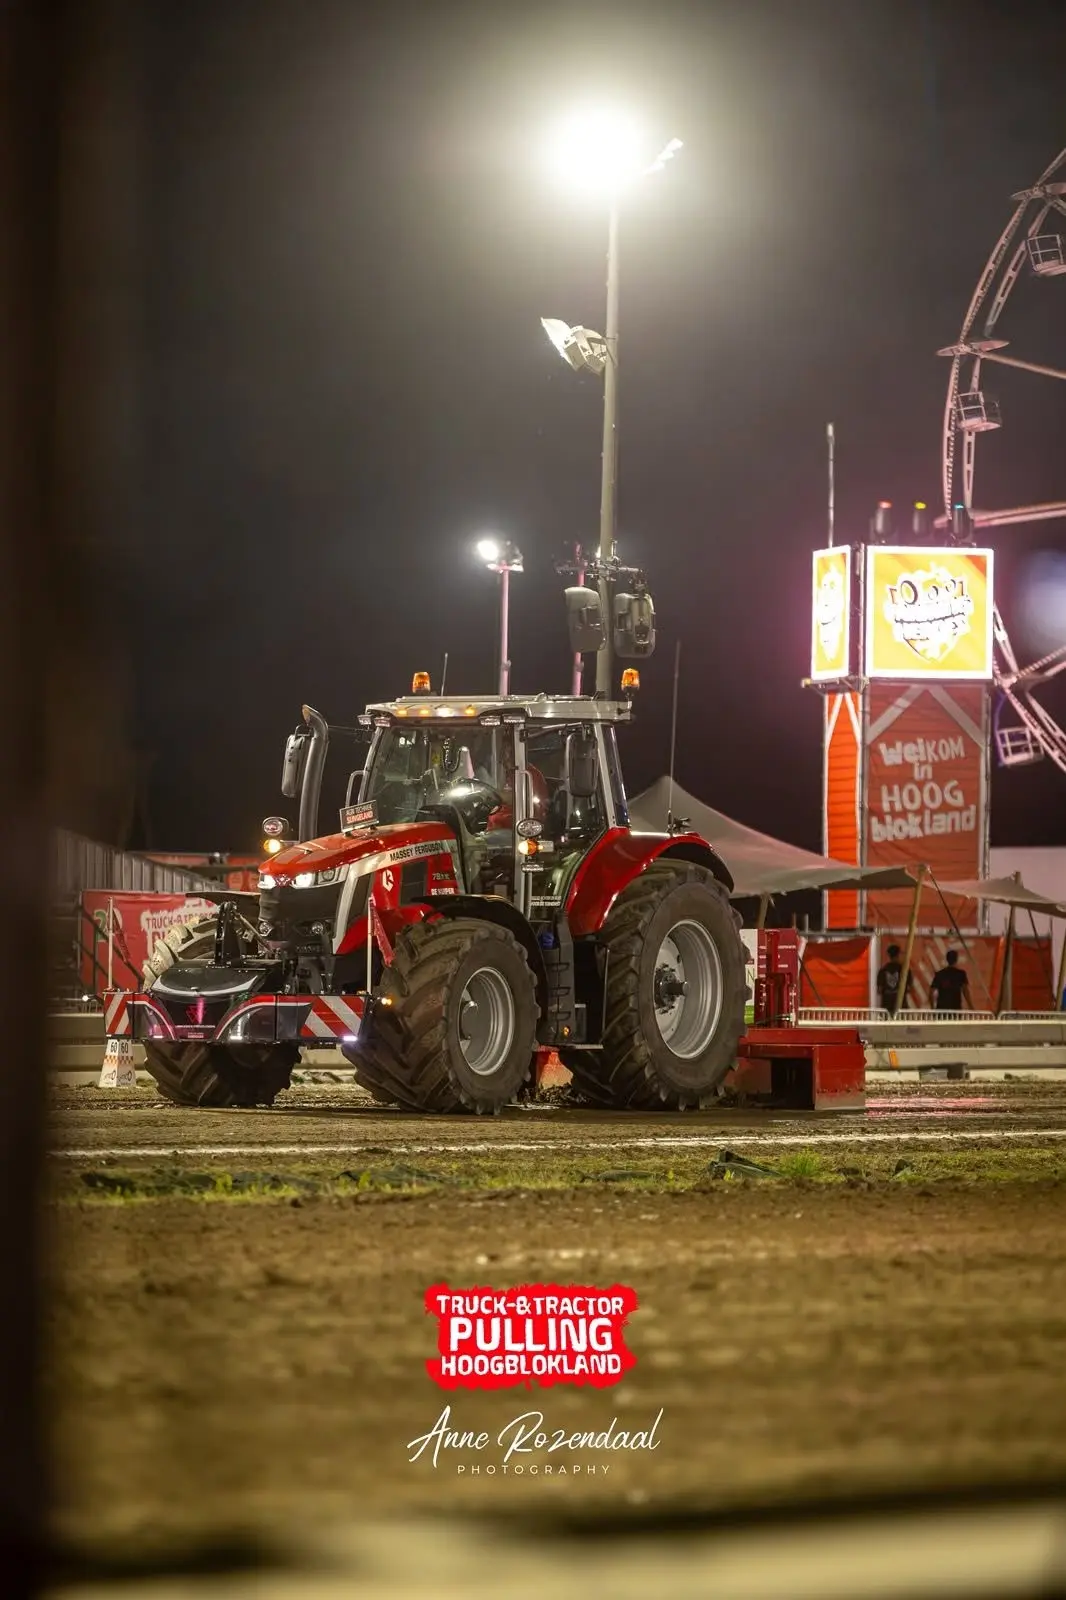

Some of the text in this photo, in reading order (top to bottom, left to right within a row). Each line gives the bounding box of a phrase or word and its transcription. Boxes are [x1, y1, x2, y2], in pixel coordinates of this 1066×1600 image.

[914, 760, 933, 780] in
[881, 780, 964, 812] HOOG
[390, 841, 444, 861] MASSEY FERGUSON
[110, 1042, 118, 1053] 60
[120, 1043, 129, 1054] 60
